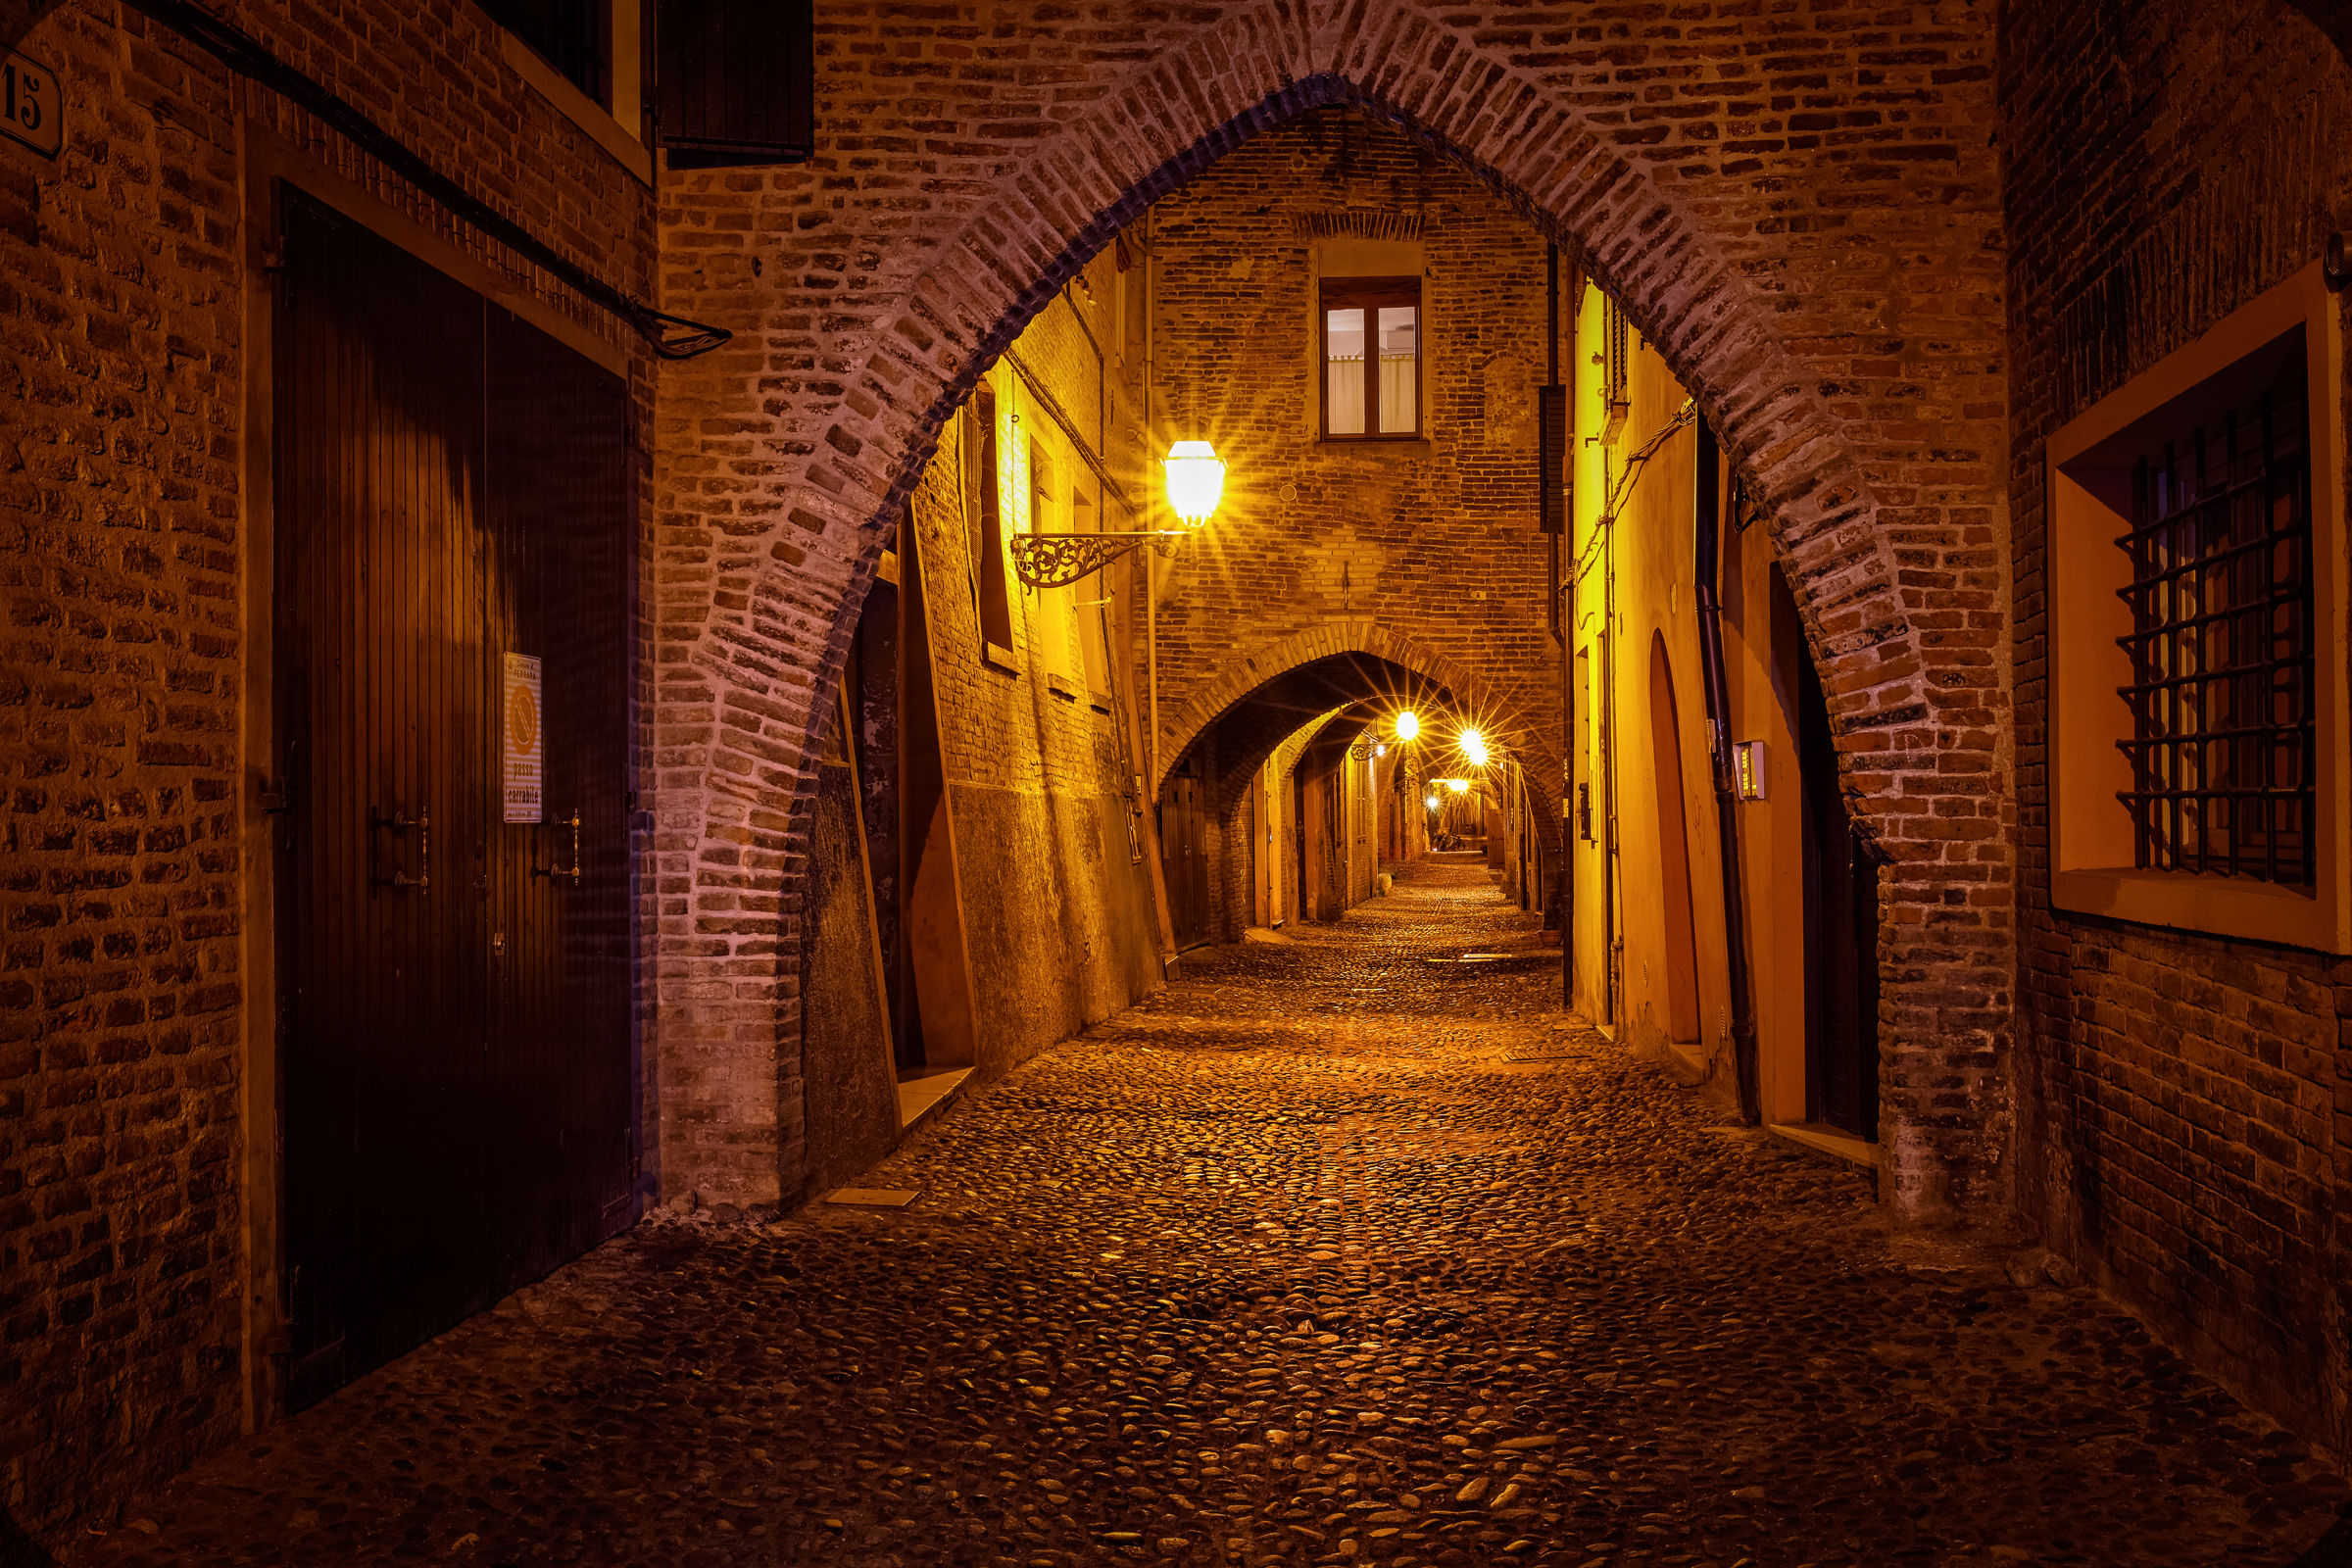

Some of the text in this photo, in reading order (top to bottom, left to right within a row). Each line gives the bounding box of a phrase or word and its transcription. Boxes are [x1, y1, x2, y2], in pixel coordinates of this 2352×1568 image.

[1, 62, 42, 130] 15
[514, 668, 537, 680] FERRARA
[514, 761, 533, 782] passo
[508, 785, 539, 804] carrabile
